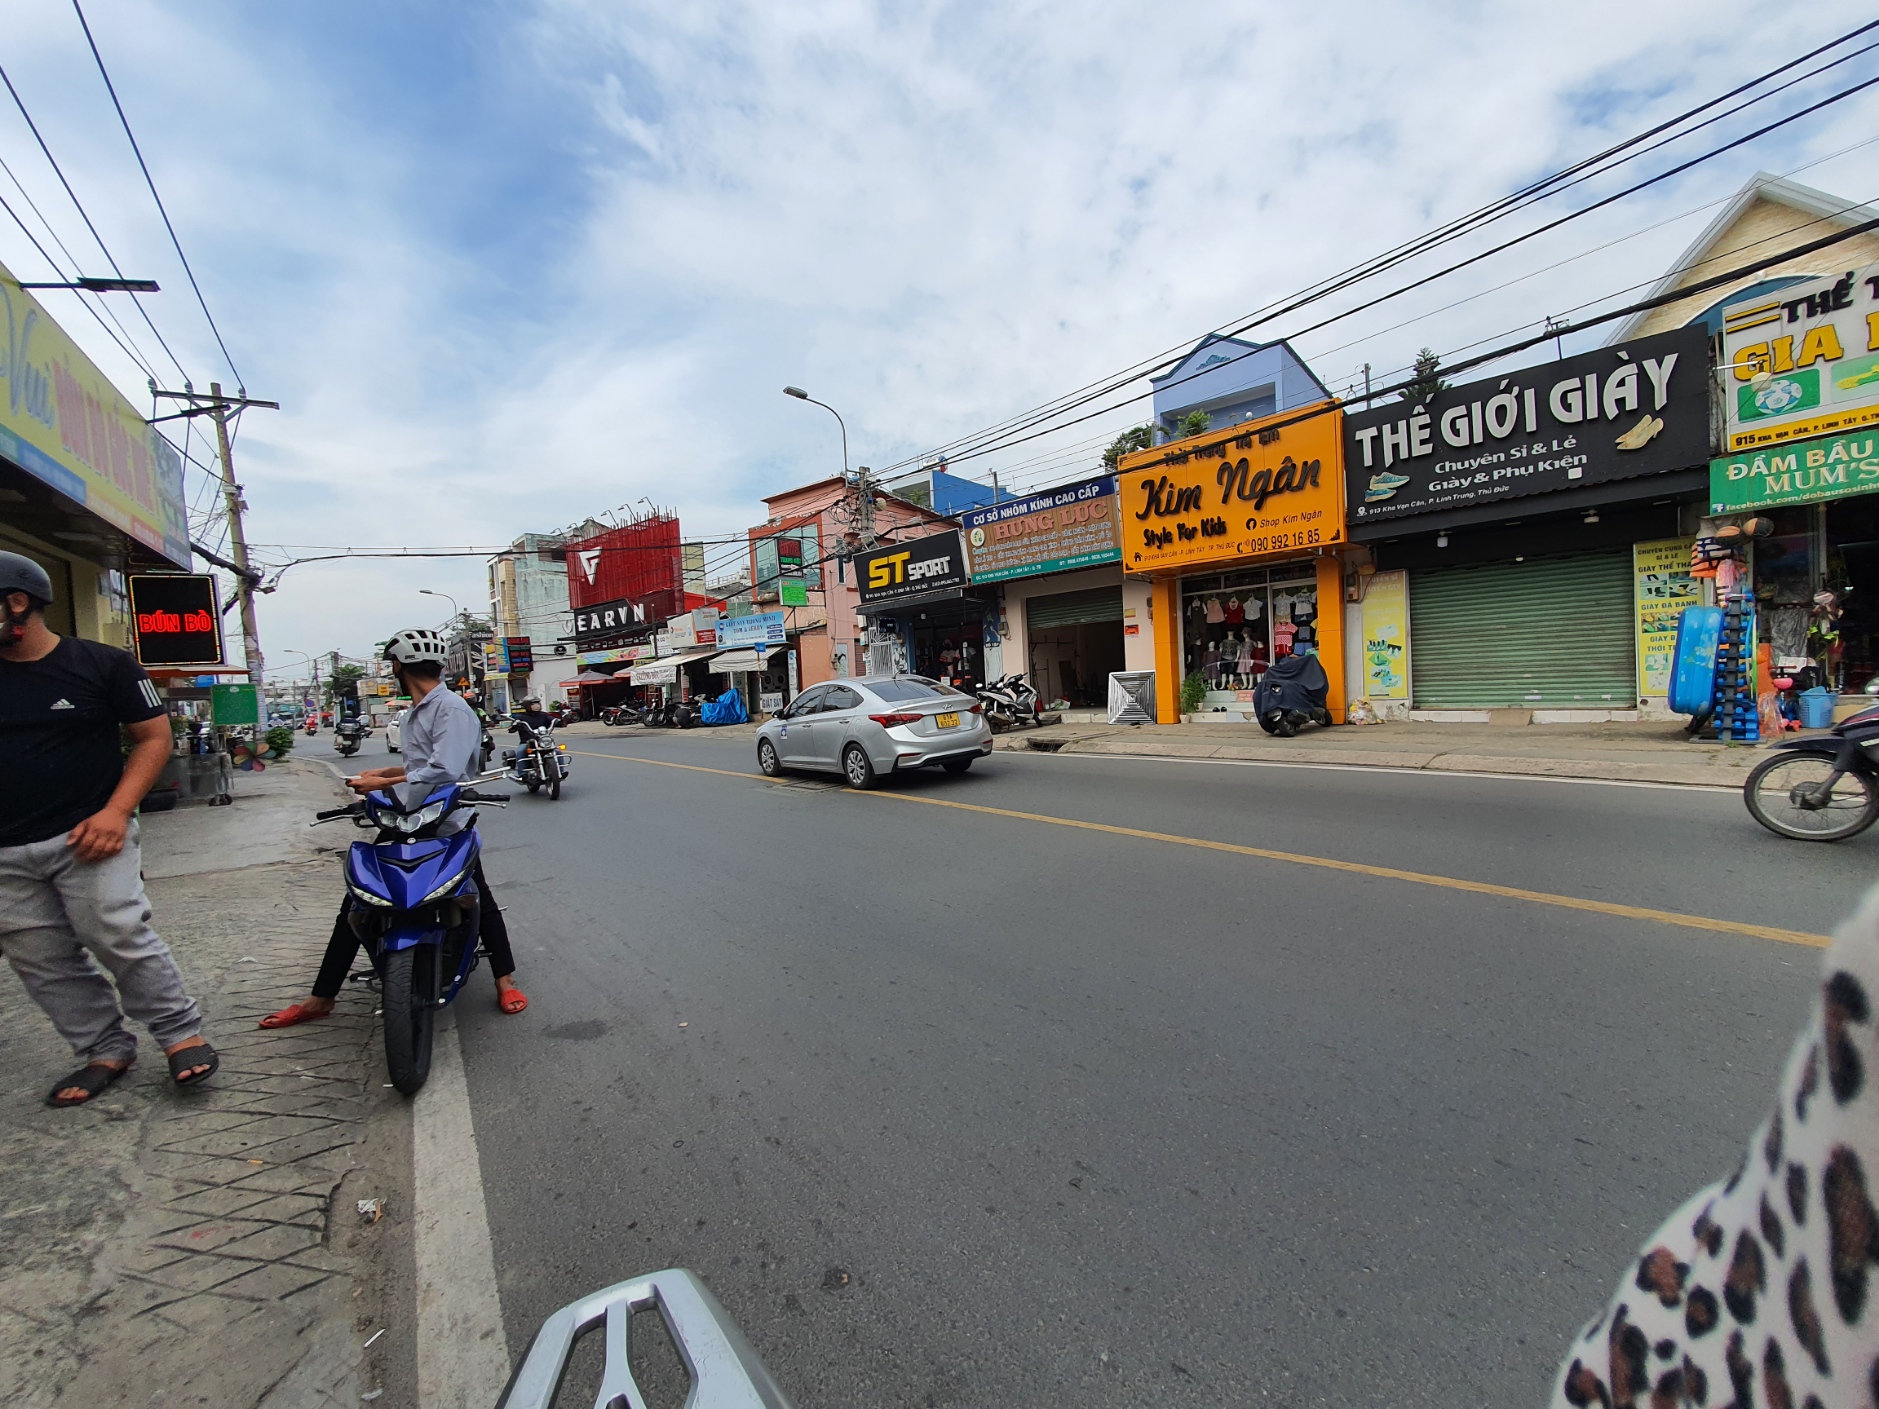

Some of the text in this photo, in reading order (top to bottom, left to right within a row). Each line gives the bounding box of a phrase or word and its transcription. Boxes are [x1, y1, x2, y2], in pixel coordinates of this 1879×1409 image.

[1733, 323, 1844, 383] GIA
[1355, 351, 1679, 468] THẾ GIỚI GIÀY
[1736, 434, 1756, 446] 915
[1758, 434, 1772, 442] KHA
[1822, 420, 1839, 430] LINH
[1842, 416, 1858, 426] TÂY
[1434, 434, 1578, 475] Chuyên Sỉ & Lẻ
[1474, 471, 1490, 484] &
[1493, 462, 1534, 482] Phụ
[1538, 452, 1588, 475] Kiện
[1726, 438, 1874, 482] ĐẦM BẦU
[1135, 456, 1321, 520] Kim Ngân
[1453, 492, 1476, 501] Trung,
[1494, 485, 1510, 493] Đức
[1764, 458, 1879, 496] MUM'S
[973, 483, 1100, 526] CƠ SỞ NHÔM KÍNH CAO CẤP
[1726, 483, 1879, 512] facebook.com/dobausosinh
[994, 500, 1108, 540] HƯNG LỰC
[1144, 516, 1227, 550] Style For Kids
[1260, 509, 1322, 529] Shop Kim Ngân
[1251, 528, 1320, 552] 090 992 16 85
[868, 551, 911, 589] ST
[908, 556, 951, 581] SPORT
[139, 610, 212, 633] BÚN BÒ
[762, 696, 782, 709] GIẶT SẤY
